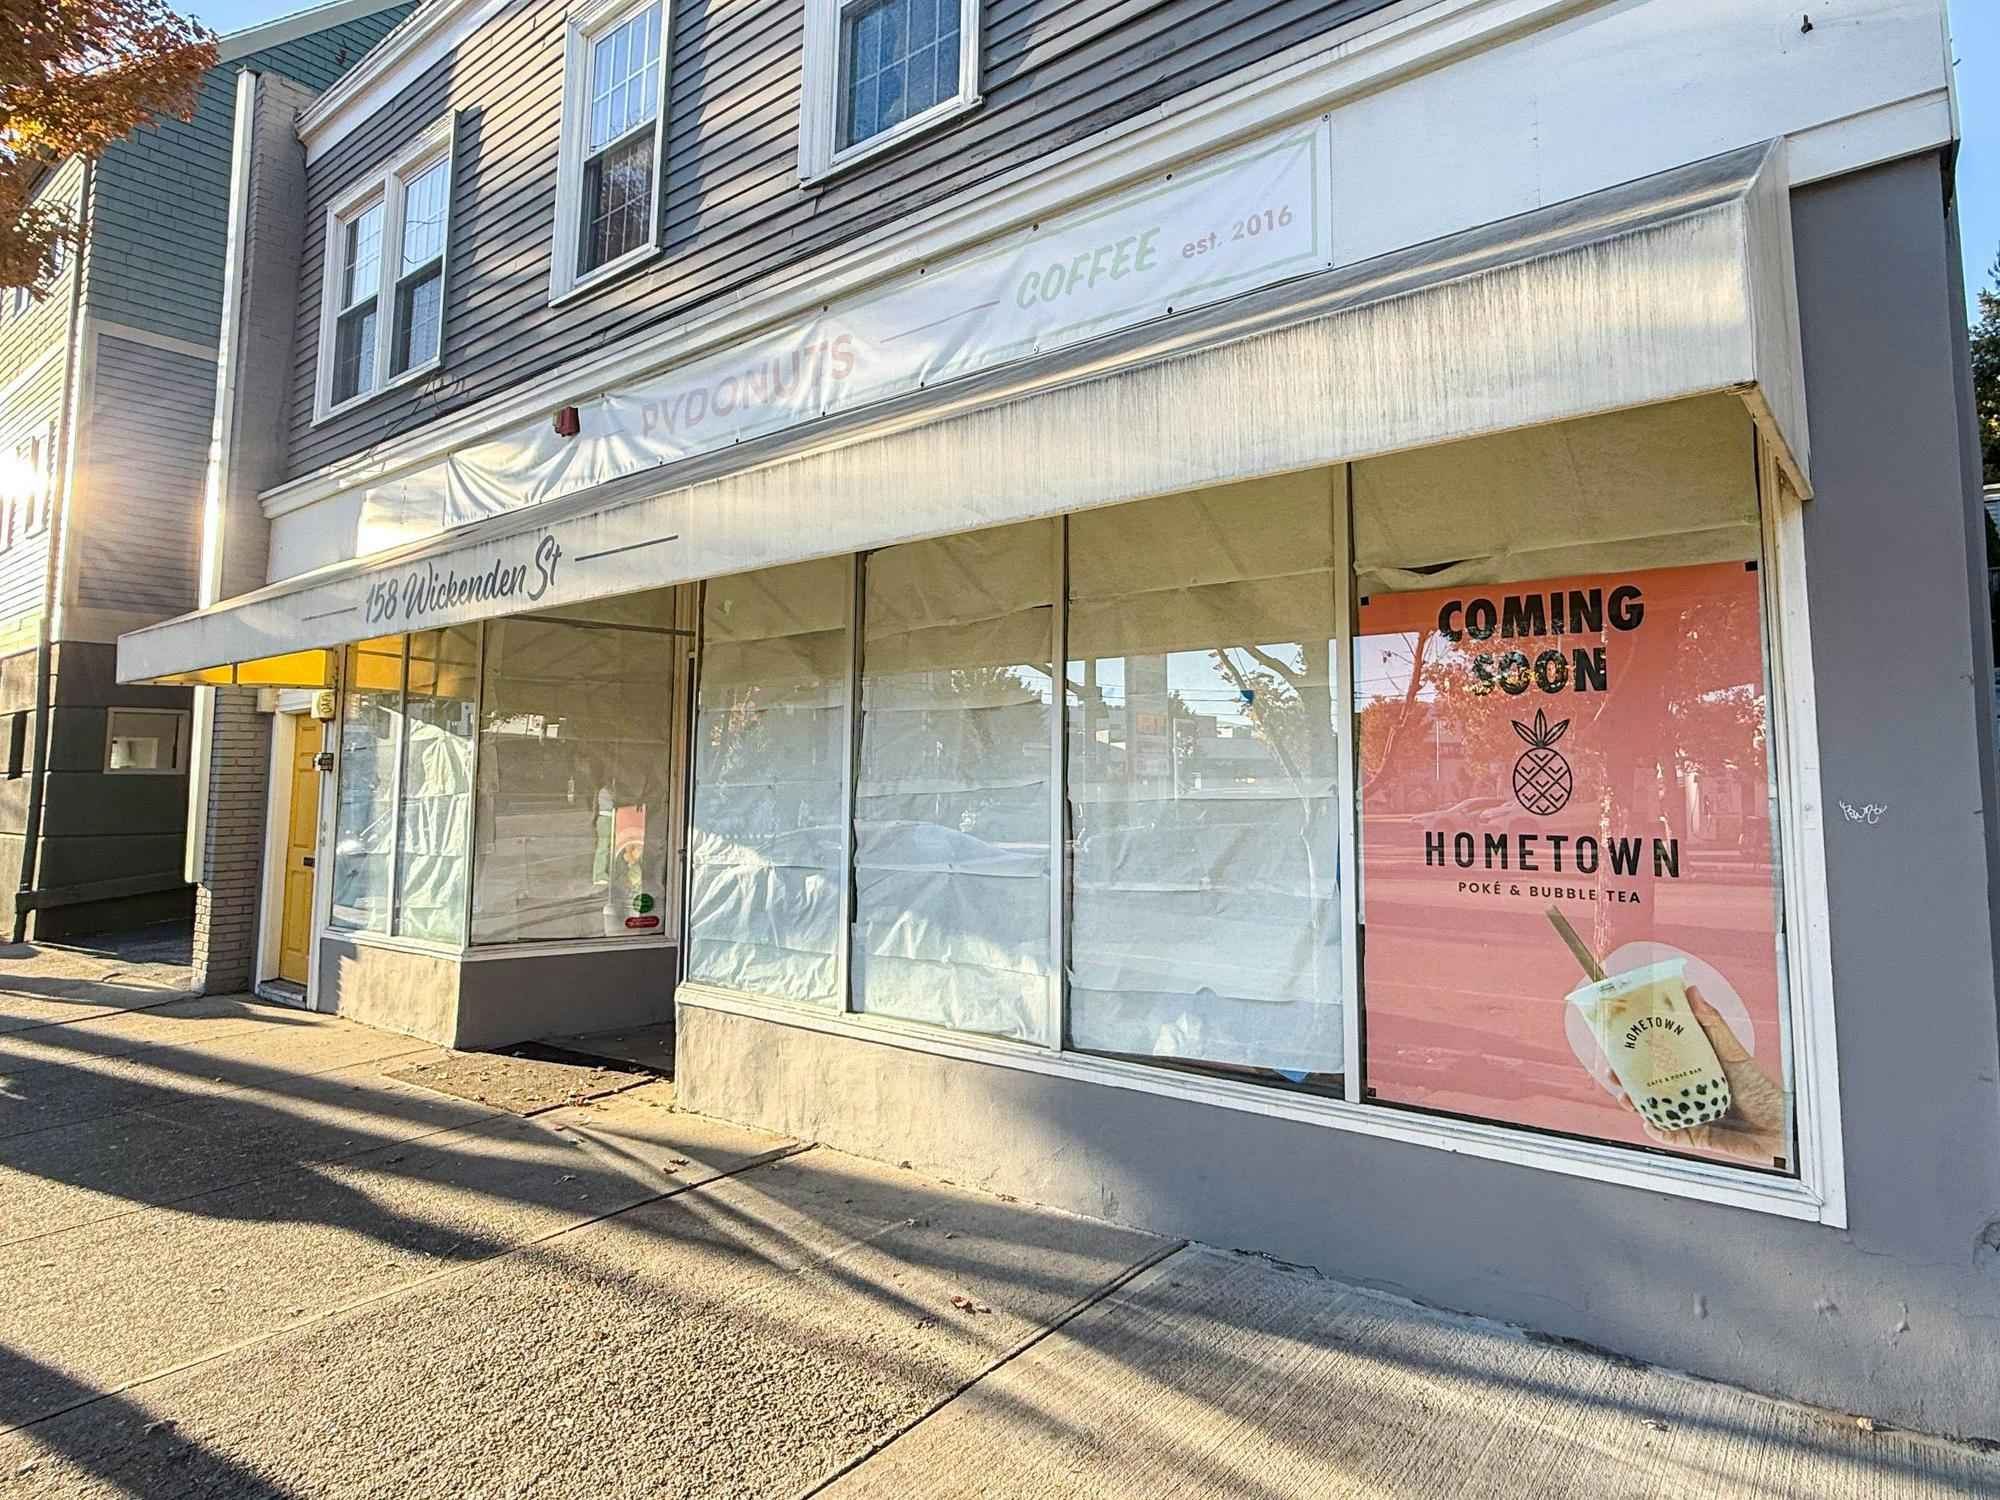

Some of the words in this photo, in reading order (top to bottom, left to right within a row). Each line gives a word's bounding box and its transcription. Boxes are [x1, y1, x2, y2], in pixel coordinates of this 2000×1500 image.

[641, 333, 856, 438] PVDONUTS
[1015, 226, 1161, 310] COFFEE
[1181, 230, 1223, 260] est.
[1230, 204, 1293, 242] 2016
[364, 578, 398, 624] 158
[403, 557, 528, 620] Wickenden
[527, 534, 563, 602] St
[1437, 584, 1645, 643] COMING
[1471, 646, 1608, 696] SOON
[1424, 830, 1680, 879] HOMETOWN
[1458, 880, 1502, 896] POKÉ
[1509, 884, 1521, 897] &
[1528, 885, 1598, 901] BUBBLE
[1605, 889, 1641, 904] TEA
[1624, 1016, 1685, 1049] HOMETOWN
